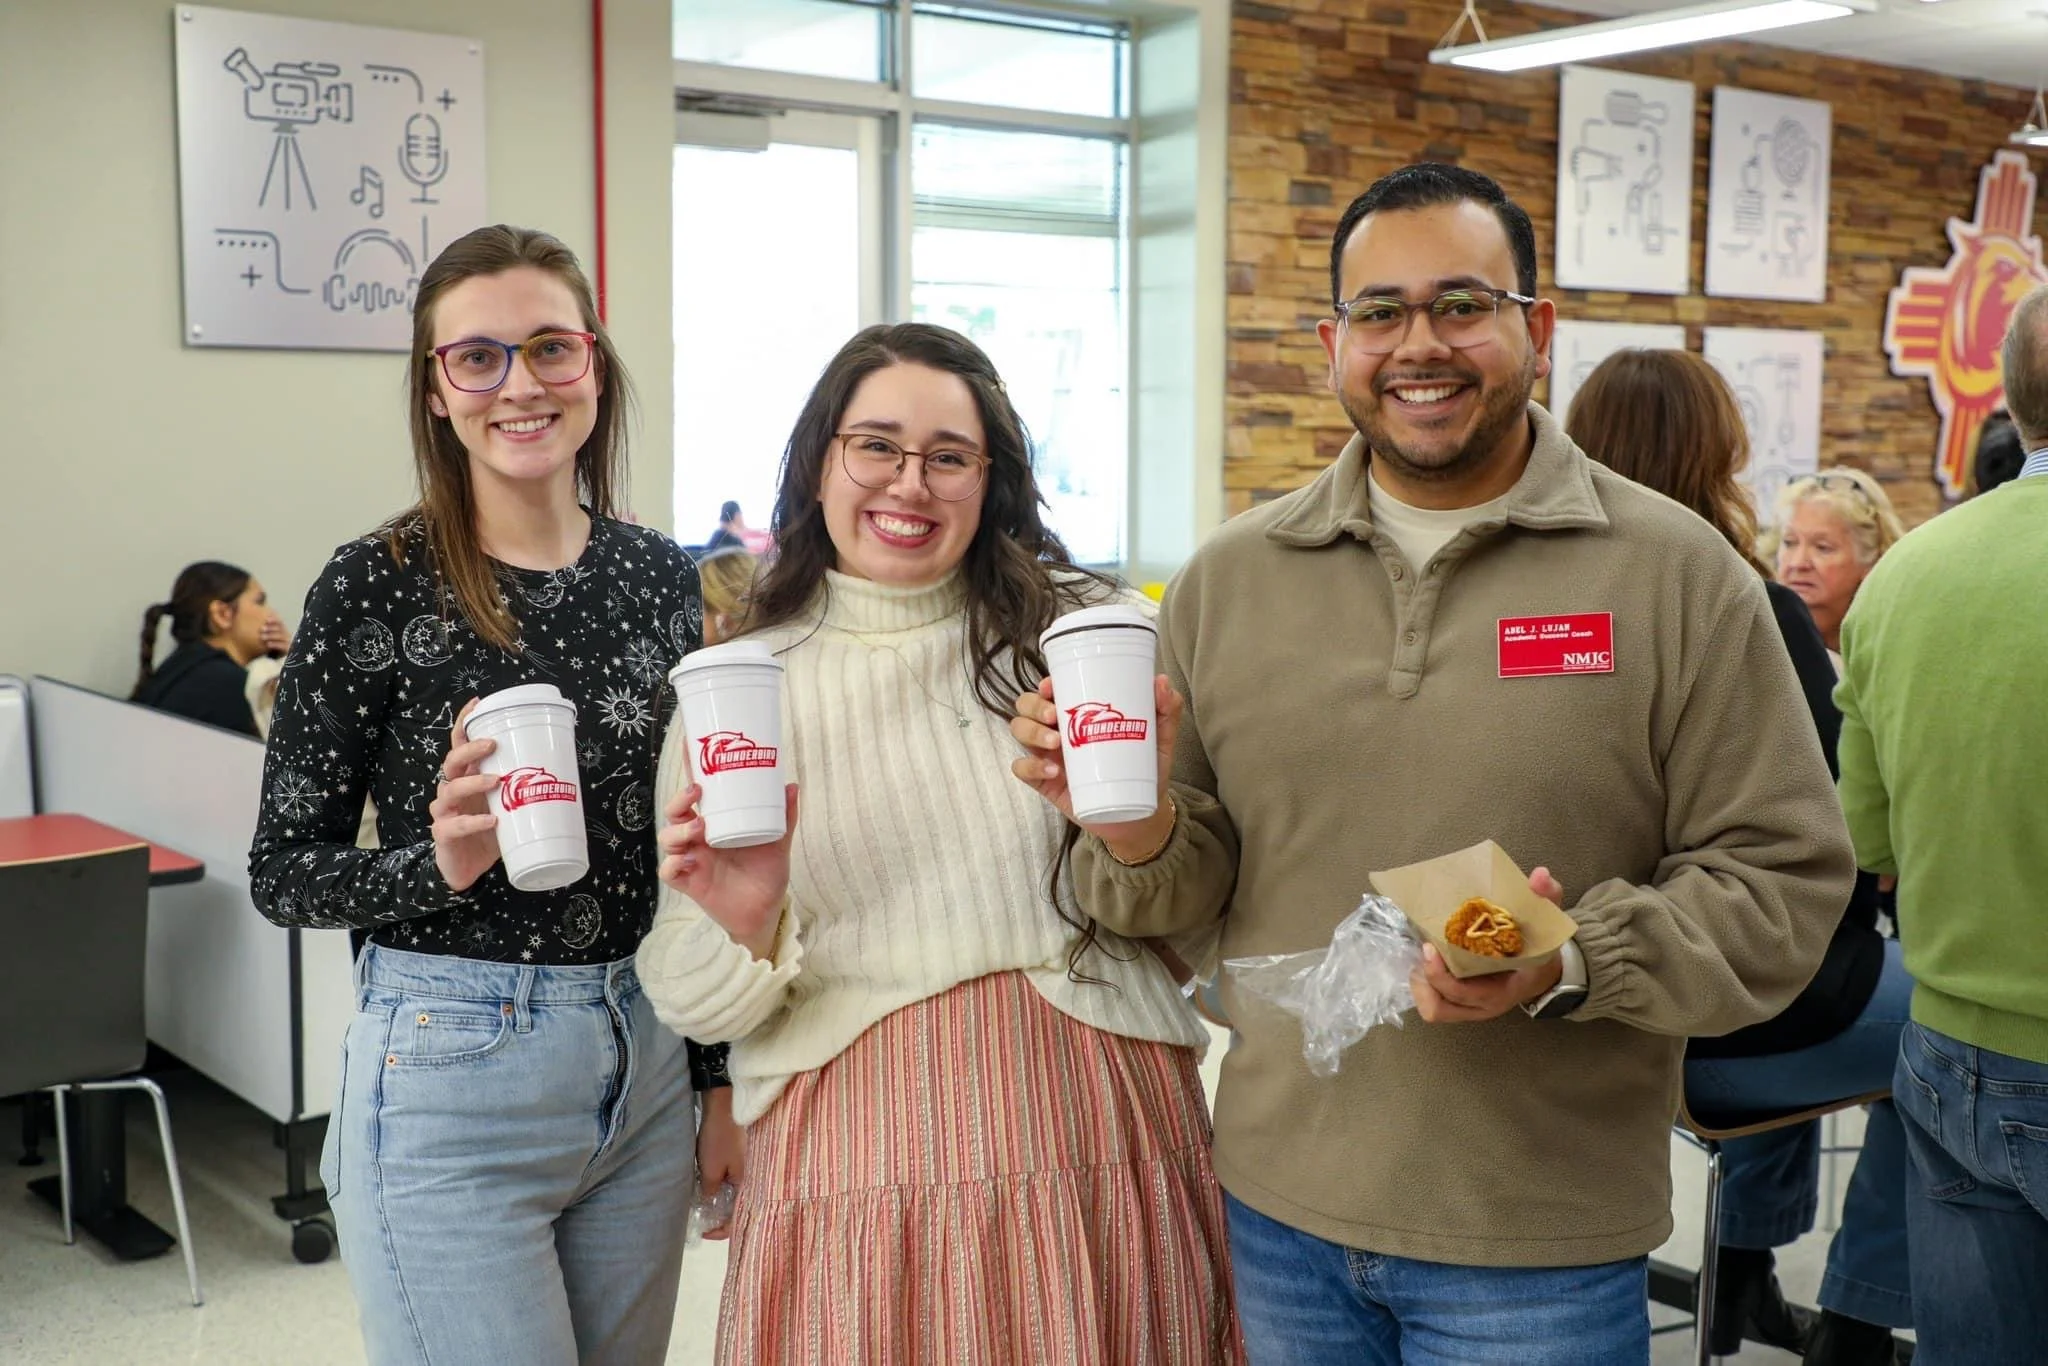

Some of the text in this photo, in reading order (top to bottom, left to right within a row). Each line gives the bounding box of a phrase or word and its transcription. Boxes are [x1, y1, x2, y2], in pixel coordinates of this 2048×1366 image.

[1504, 623, 1570, 635] ABEL J. LUJAN
[1504, 630, 1594, 642] Academic Success Coach
[1563, 651, 1610, 666] NMJC
[1082, 721, 1146, 737] THUNDERBIRD
[715, 748, 776, 765] THUNDERBIRD
[517, 783, 576, 800] THUNDERBIRD
